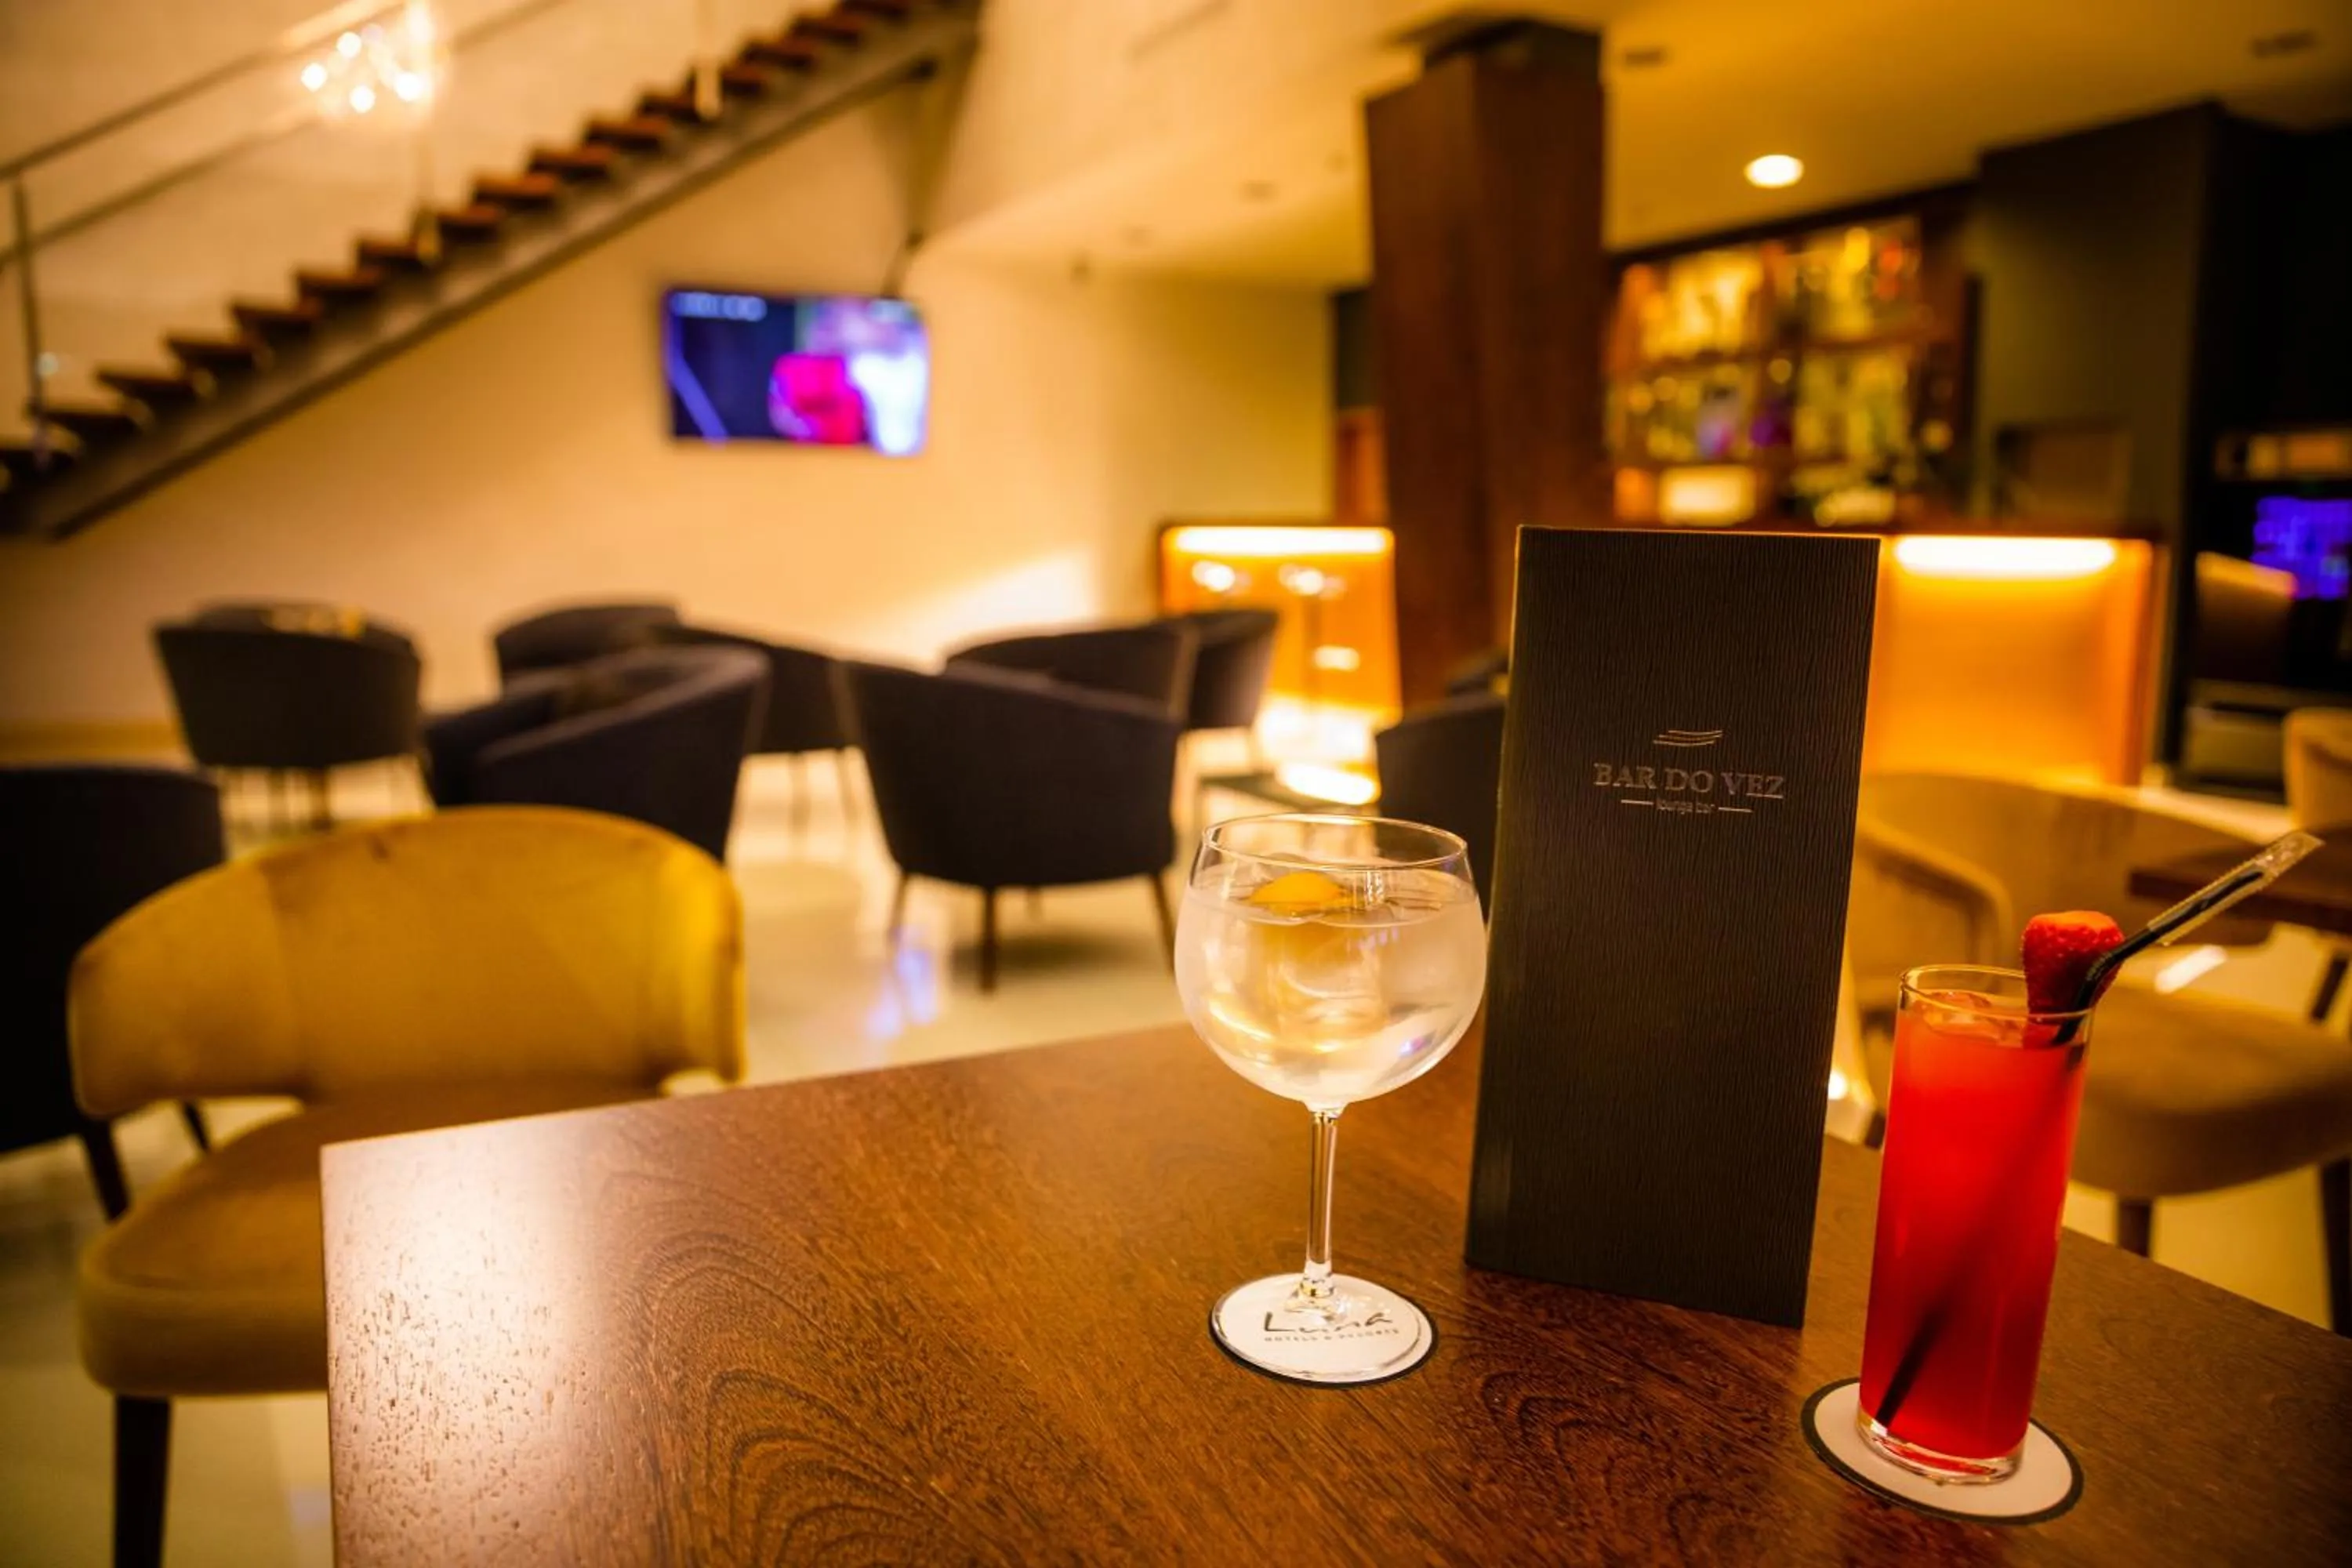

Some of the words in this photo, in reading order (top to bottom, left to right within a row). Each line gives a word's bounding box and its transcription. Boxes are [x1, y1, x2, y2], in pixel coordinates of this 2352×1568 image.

[1593, 763, 1657, 789] BAR
[1664, 768, 1715, 793] DO
[1721, 772, 1784, 798] VEZ
